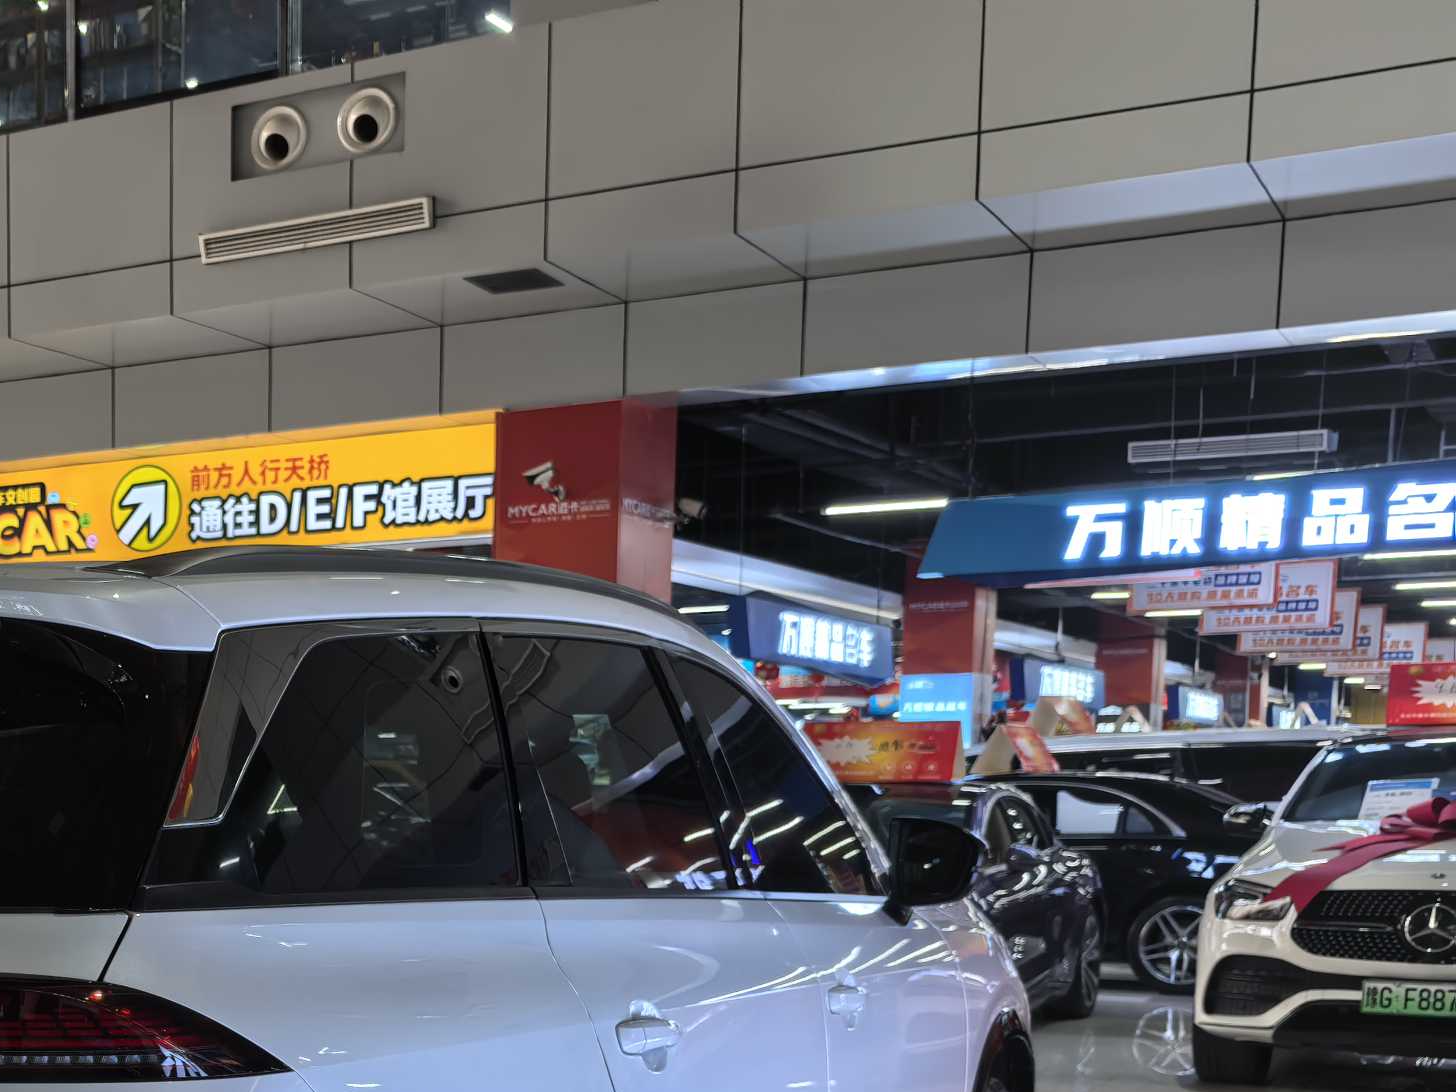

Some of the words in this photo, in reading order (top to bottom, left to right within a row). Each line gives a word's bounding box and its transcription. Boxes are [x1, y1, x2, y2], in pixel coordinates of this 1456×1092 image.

[190, 453, 331, 491] 前方人行天桥
[189, 473, 494, 541] 通往D/E/F馆展厅
[1062, 482, 1456, 561] 万顺精品名
